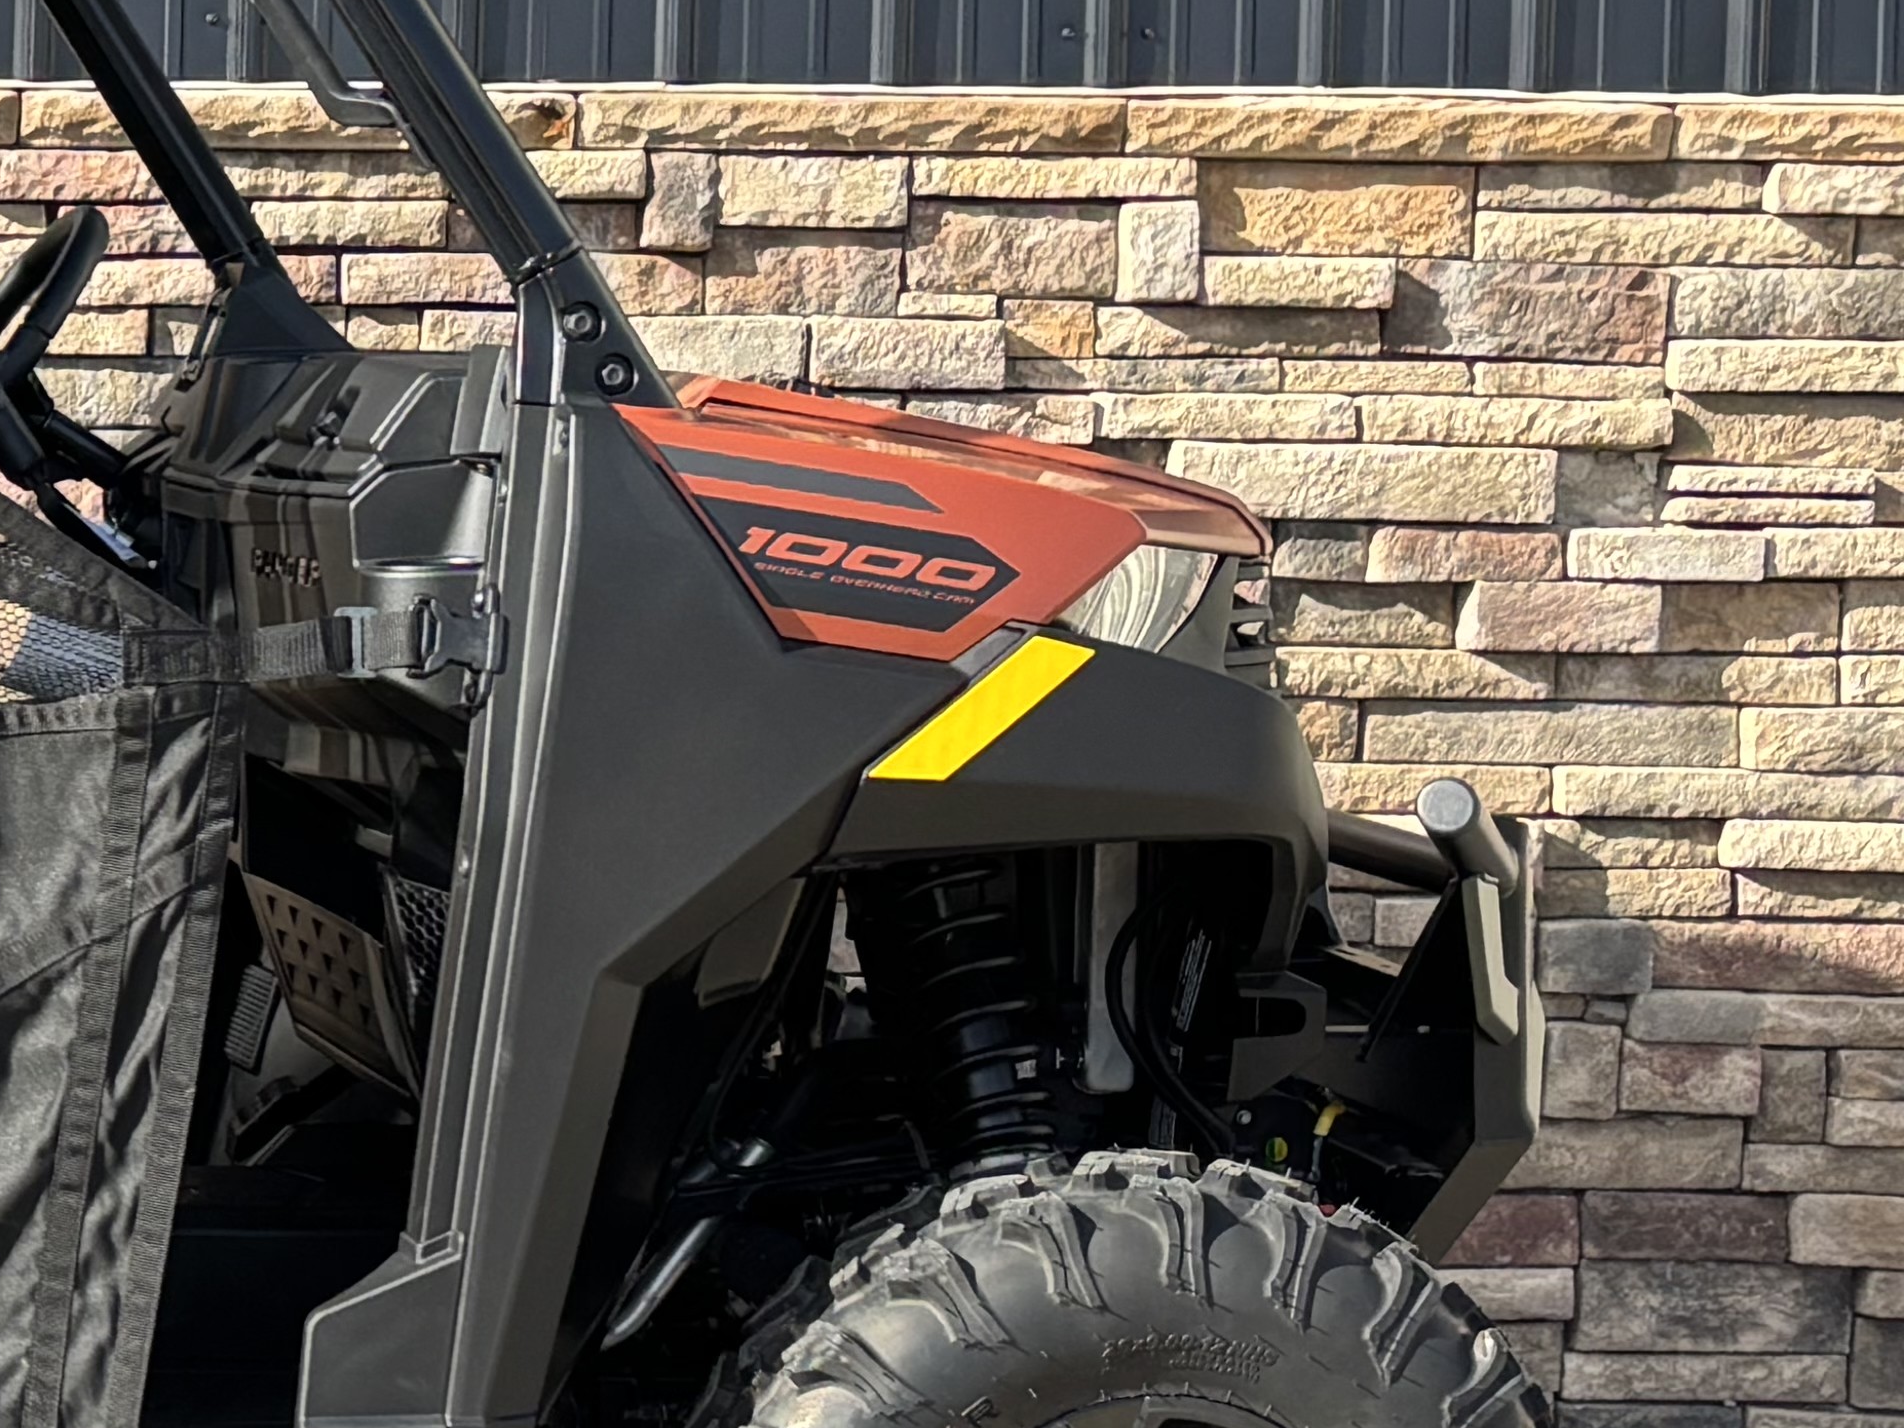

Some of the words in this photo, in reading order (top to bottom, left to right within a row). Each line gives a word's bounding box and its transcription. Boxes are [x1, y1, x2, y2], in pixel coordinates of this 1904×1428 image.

[738, 526, 996, 592] 1000
[753, 561, 825, 580] SINGLE
[829, 574, 932, 599] OVERHEAD
[933, 591, 976, 606] CAM
